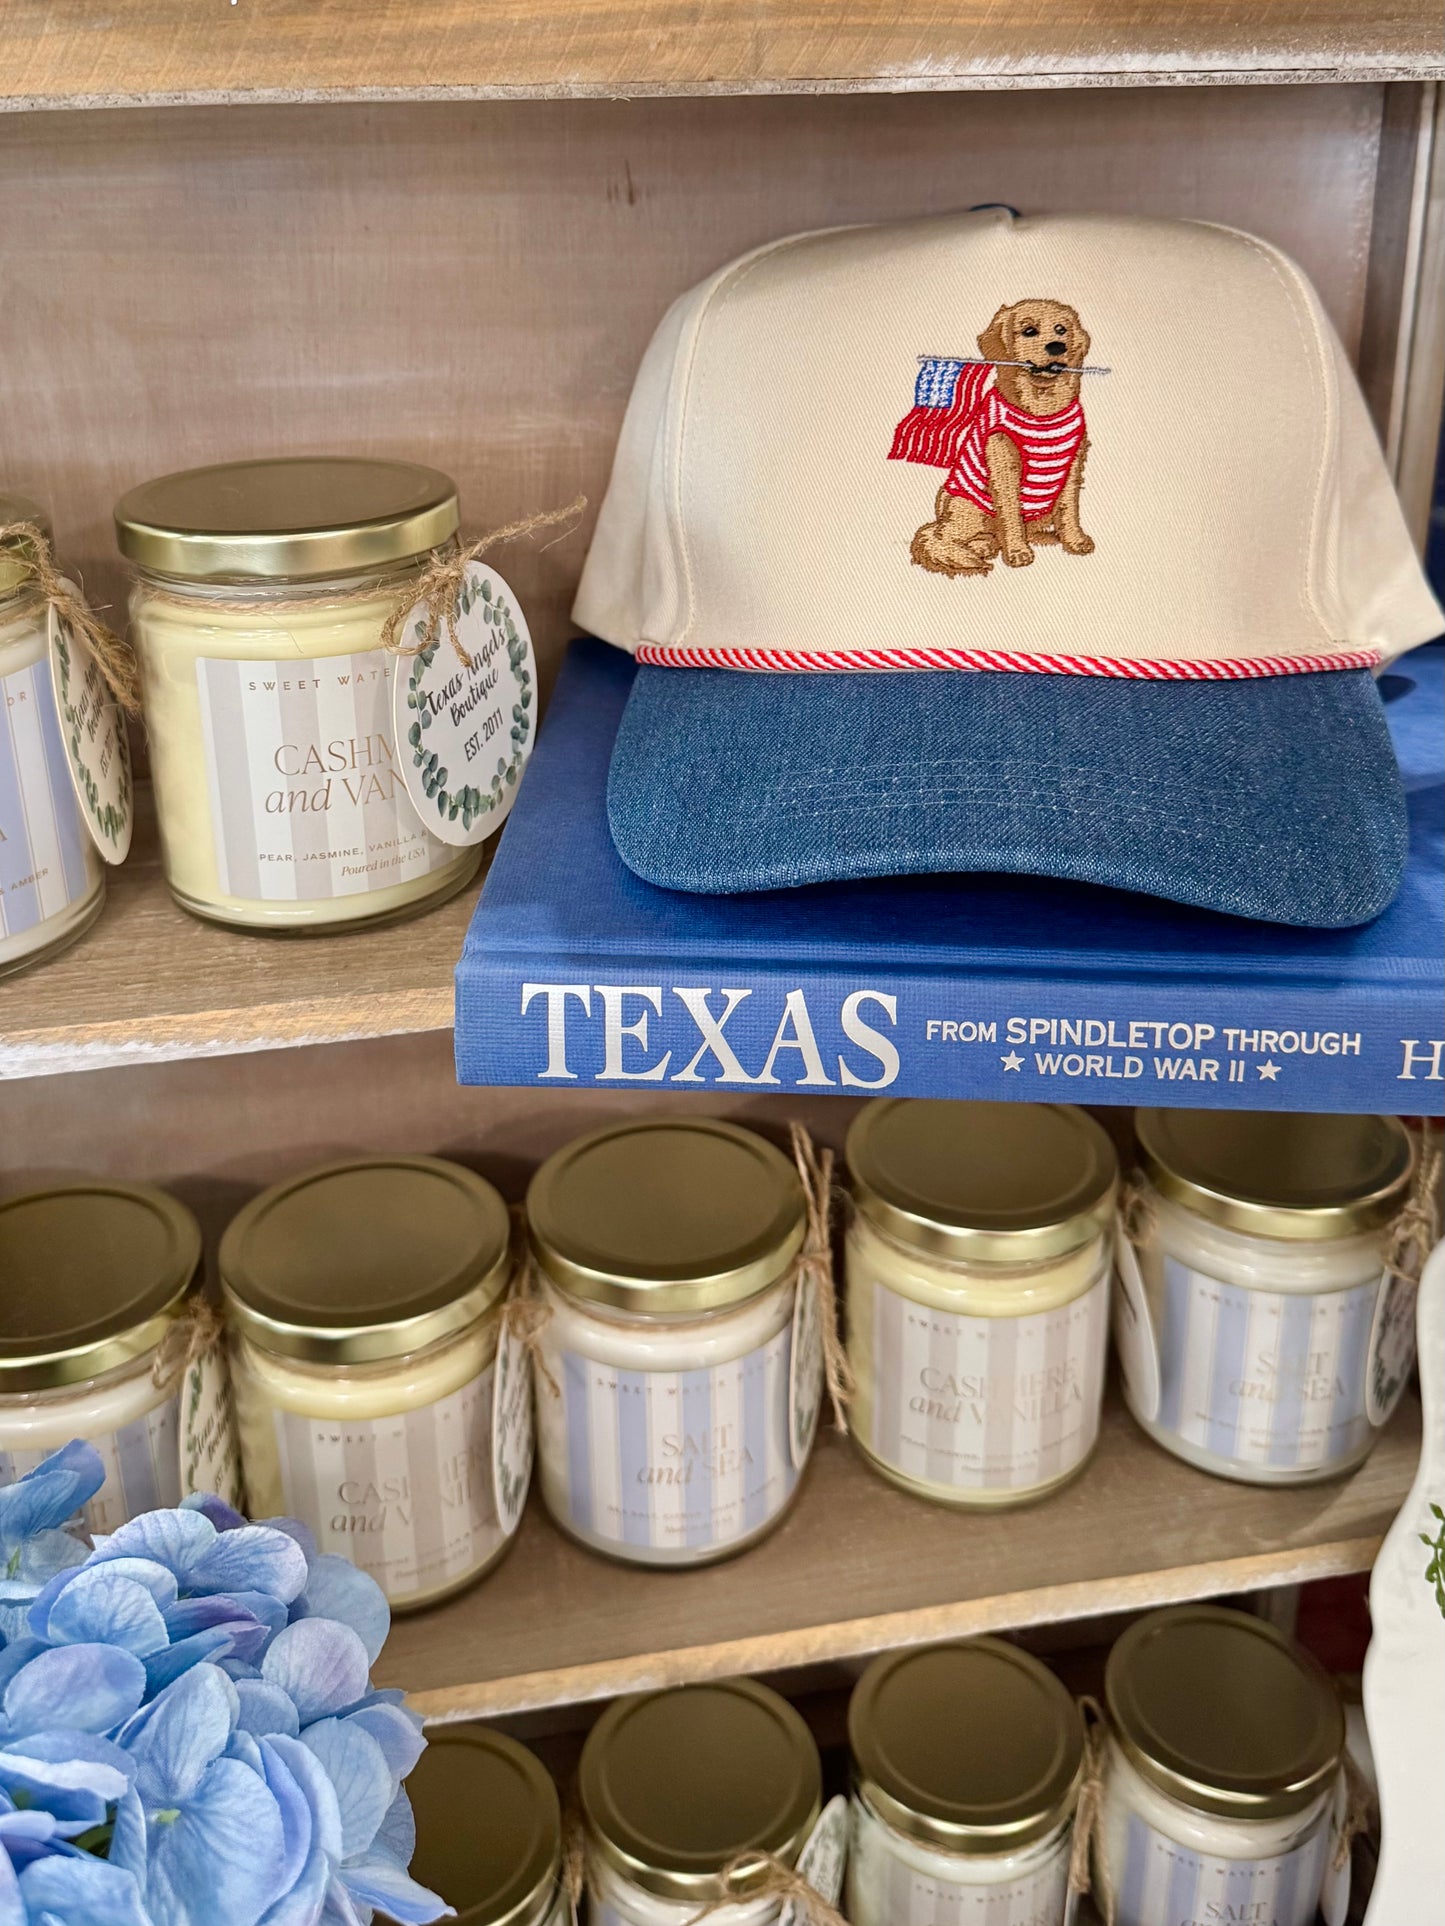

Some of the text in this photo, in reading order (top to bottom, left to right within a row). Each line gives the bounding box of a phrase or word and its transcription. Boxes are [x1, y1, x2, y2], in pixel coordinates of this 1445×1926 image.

[248, 679, 321, 691] SWEET
[426, 673, 464, 716] Texas
[450, 668, 499, 727] Boutique
[464, 708, 504, 762] EST. 2011
[265, 778, 332, 813] and
[259, 853, 297, 862] PEAR,
[303, 847, 364, 861] JASMINE,
[368, 833, 417, 852] VANILLA
[341, 847, 426, 876] Poured in the USA
[11, 867, 49, 891] AMBER
[521, 982, 900, 1089] TEXAS
[926, 1017, 1361, 1055] FROM SPINDLETOP THROUGH
[1034, 1053, 1245, 1082] WORLD WAR II
[637, 1459, 695, 1486] and
